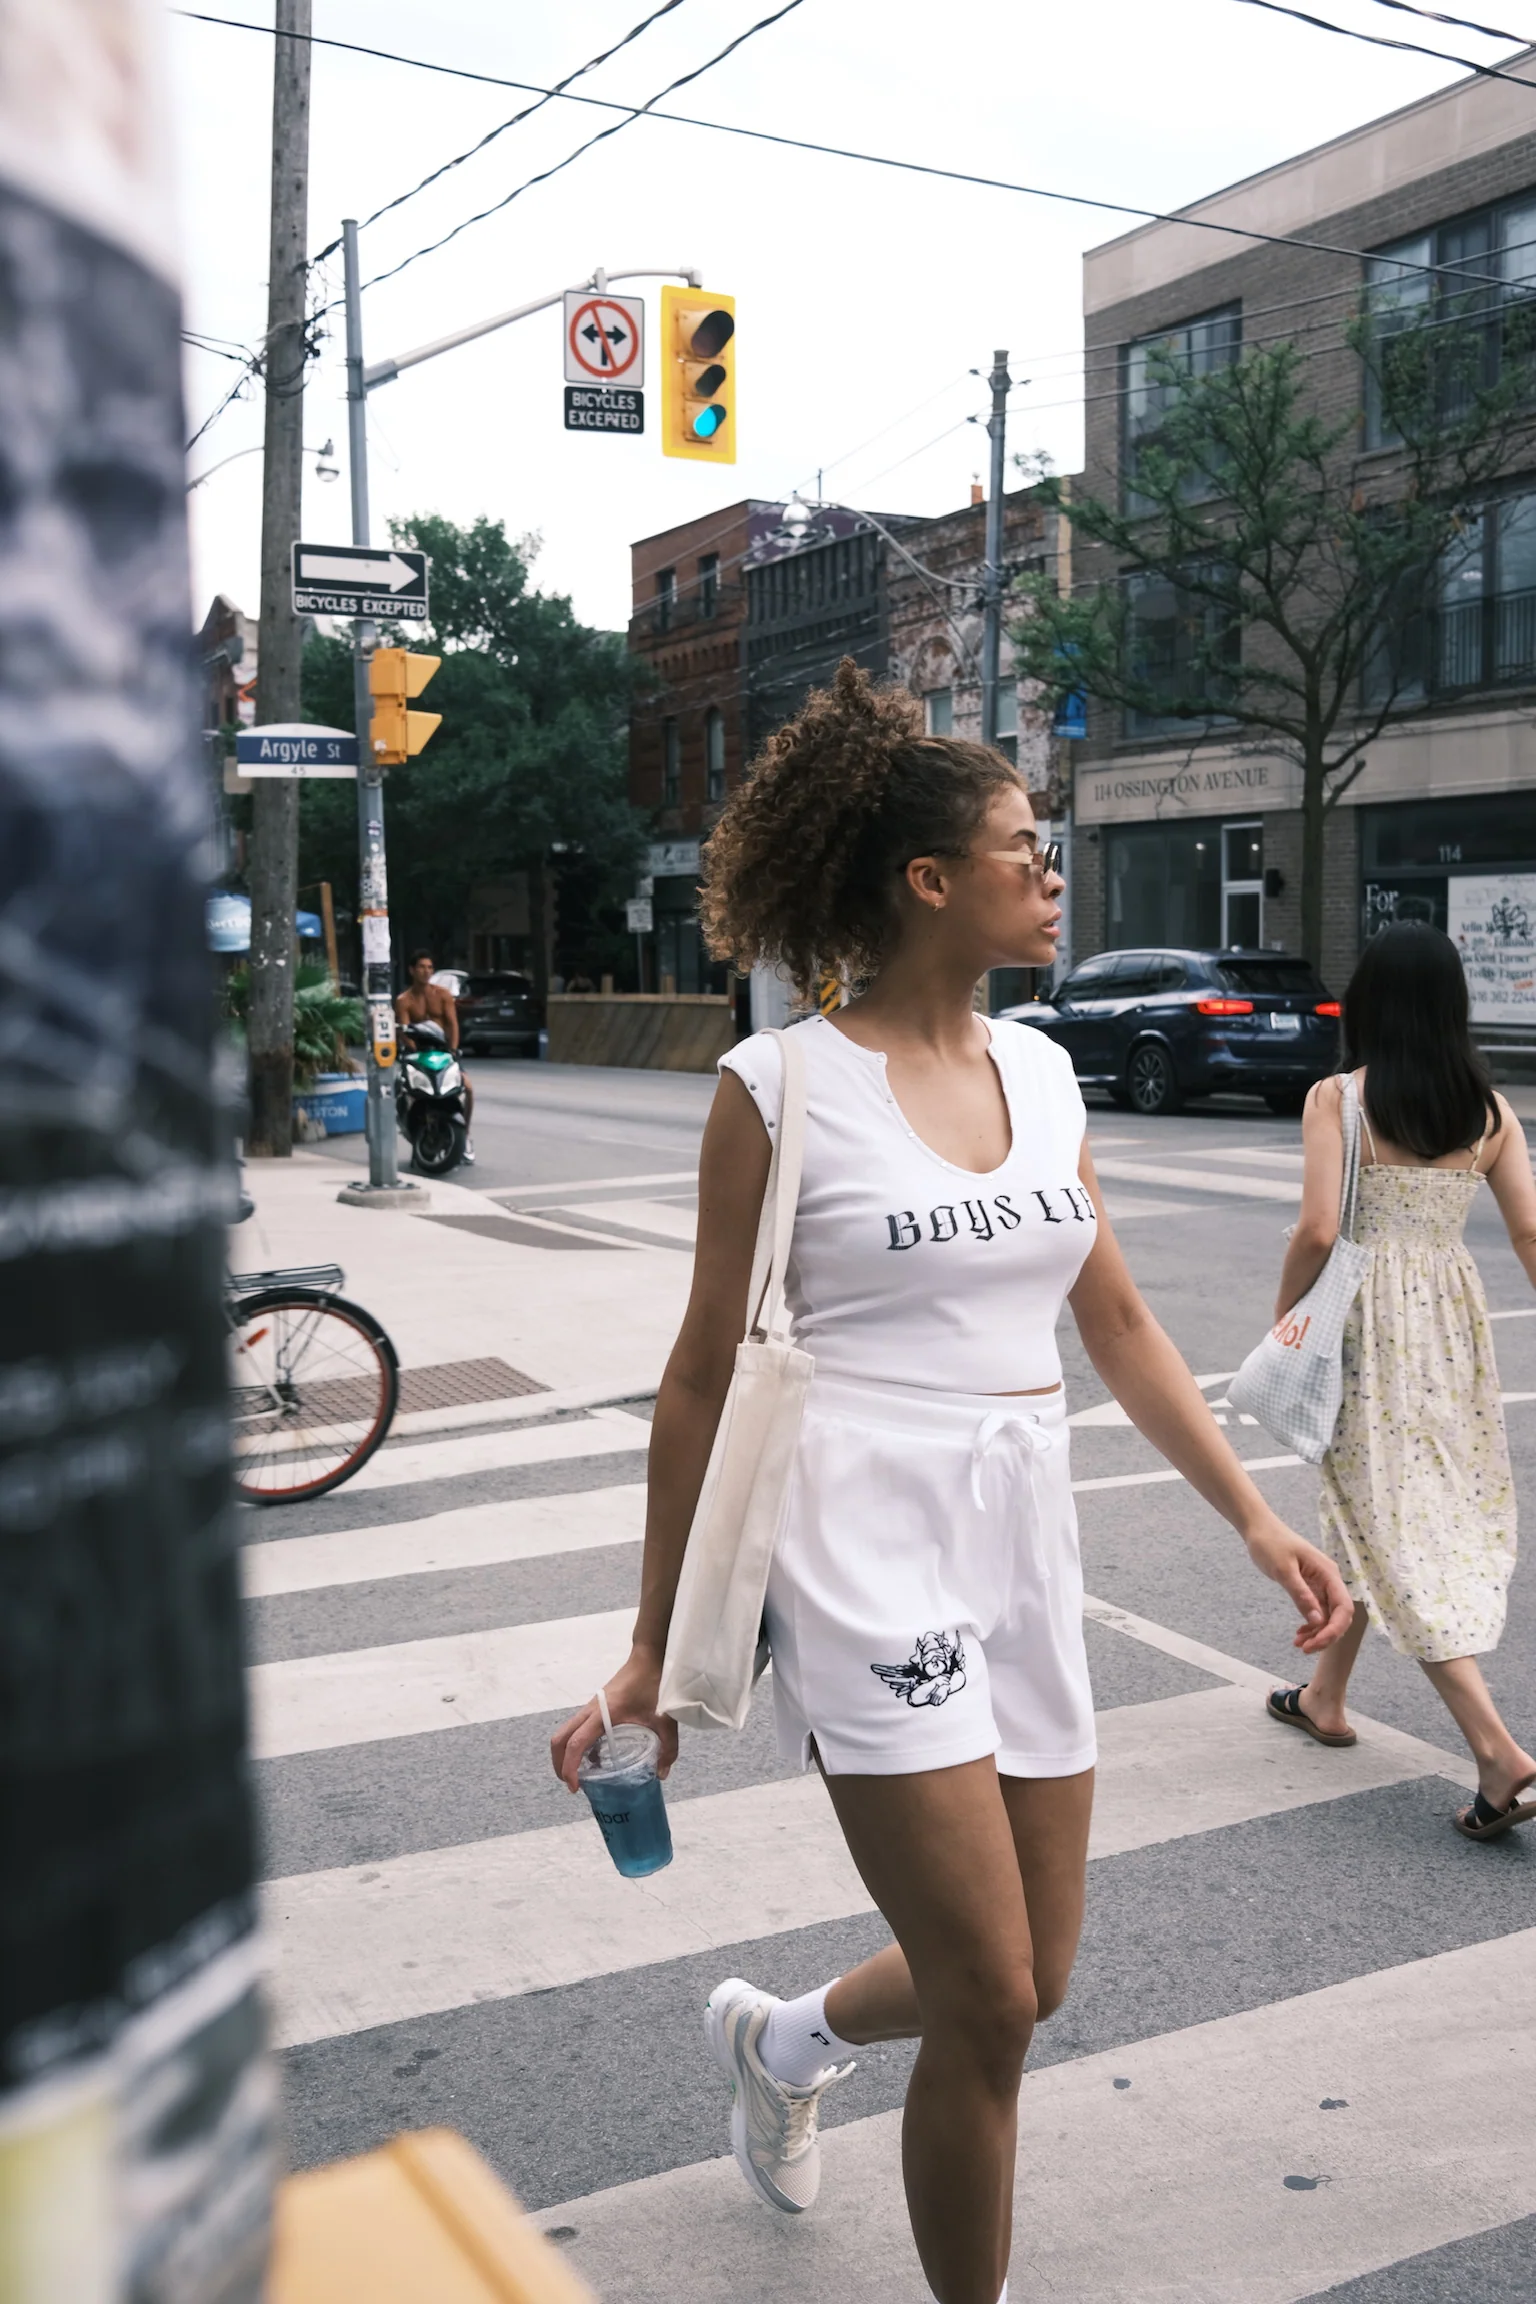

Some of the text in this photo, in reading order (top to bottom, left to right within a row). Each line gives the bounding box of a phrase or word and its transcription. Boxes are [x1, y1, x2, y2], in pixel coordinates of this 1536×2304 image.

[572, 391, 636, 411] BICYCLES
[568, 409, 640, 429] EXCEPTED
[295, 594, 427, 618] BICYCLES EXCEPTED
[260, 738, 341, 762] Argyle St
[1094, 766, 1269, 801] 114 OSSINGTON AVENUE
[1438, 845, 1461, 862] 114
[1364, 883, 1399, 914] For
[884, 1195, 1022, 1250] BOYS
